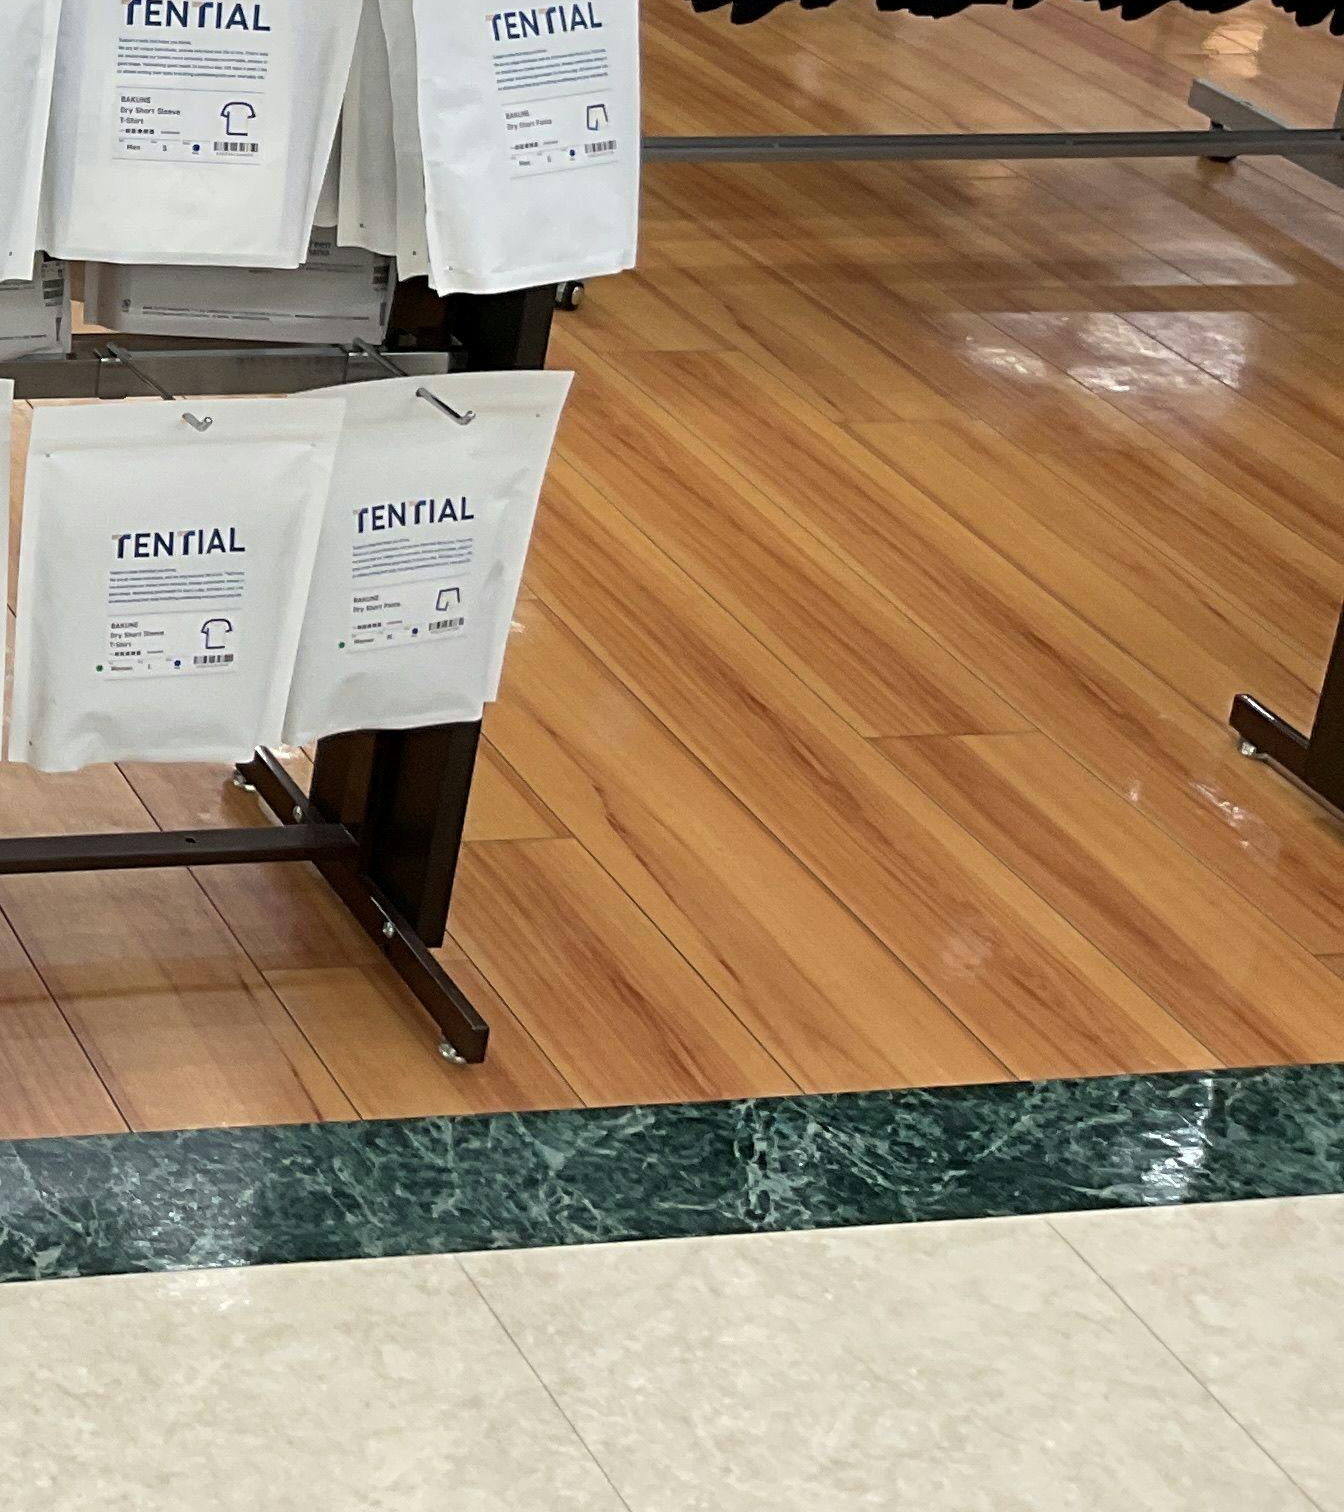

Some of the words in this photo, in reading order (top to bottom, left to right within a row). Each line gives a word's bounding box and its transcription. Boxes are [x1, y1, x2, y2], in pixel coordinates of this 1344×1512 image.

[121, 0, 271, 31] TENTIAL
[485, 2, 602, 41] TENTIAL
[353, 497, 474, 533] TENTIAL
[112, 527, 245, 559] TENTIAL
